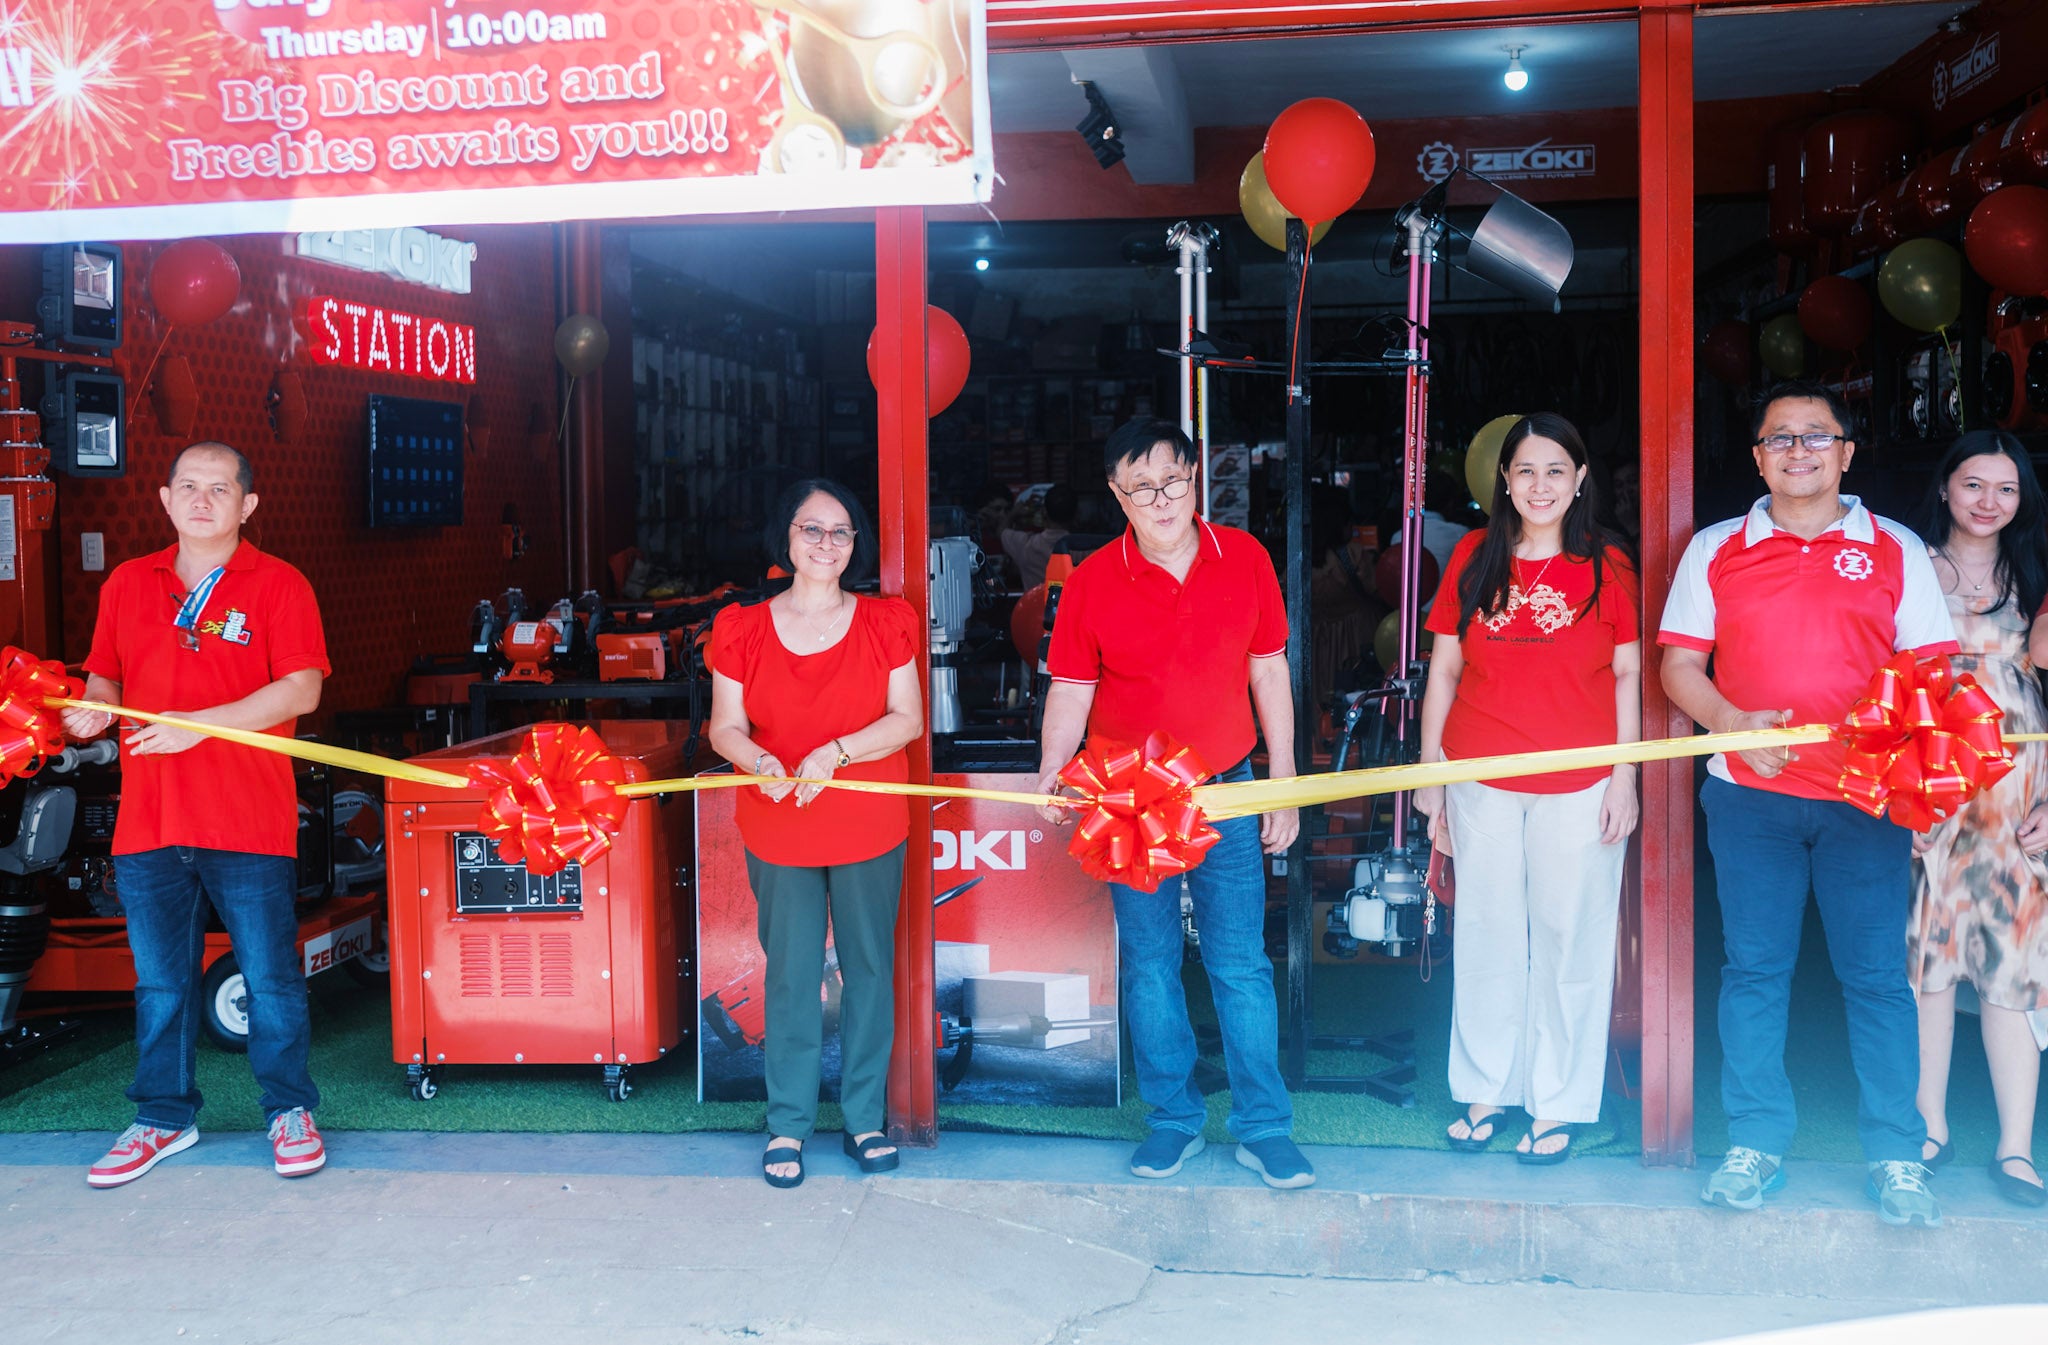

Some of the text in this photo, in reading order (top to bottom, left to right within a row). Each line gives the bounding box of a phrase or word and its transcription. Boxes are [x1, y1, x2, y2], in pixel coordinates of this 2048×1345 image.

[260, 9, 606, 58] Thursday 10:00am
[219, 51, 664, 130] Big Discount and
[168, 107, 728, 181] Freebies awaits you!!!
[1472, 139, 1584, 171] ZEKOKI
[322, 298, 476, 380] STATION
[310, 931, 364, 973] ZEKOKI
